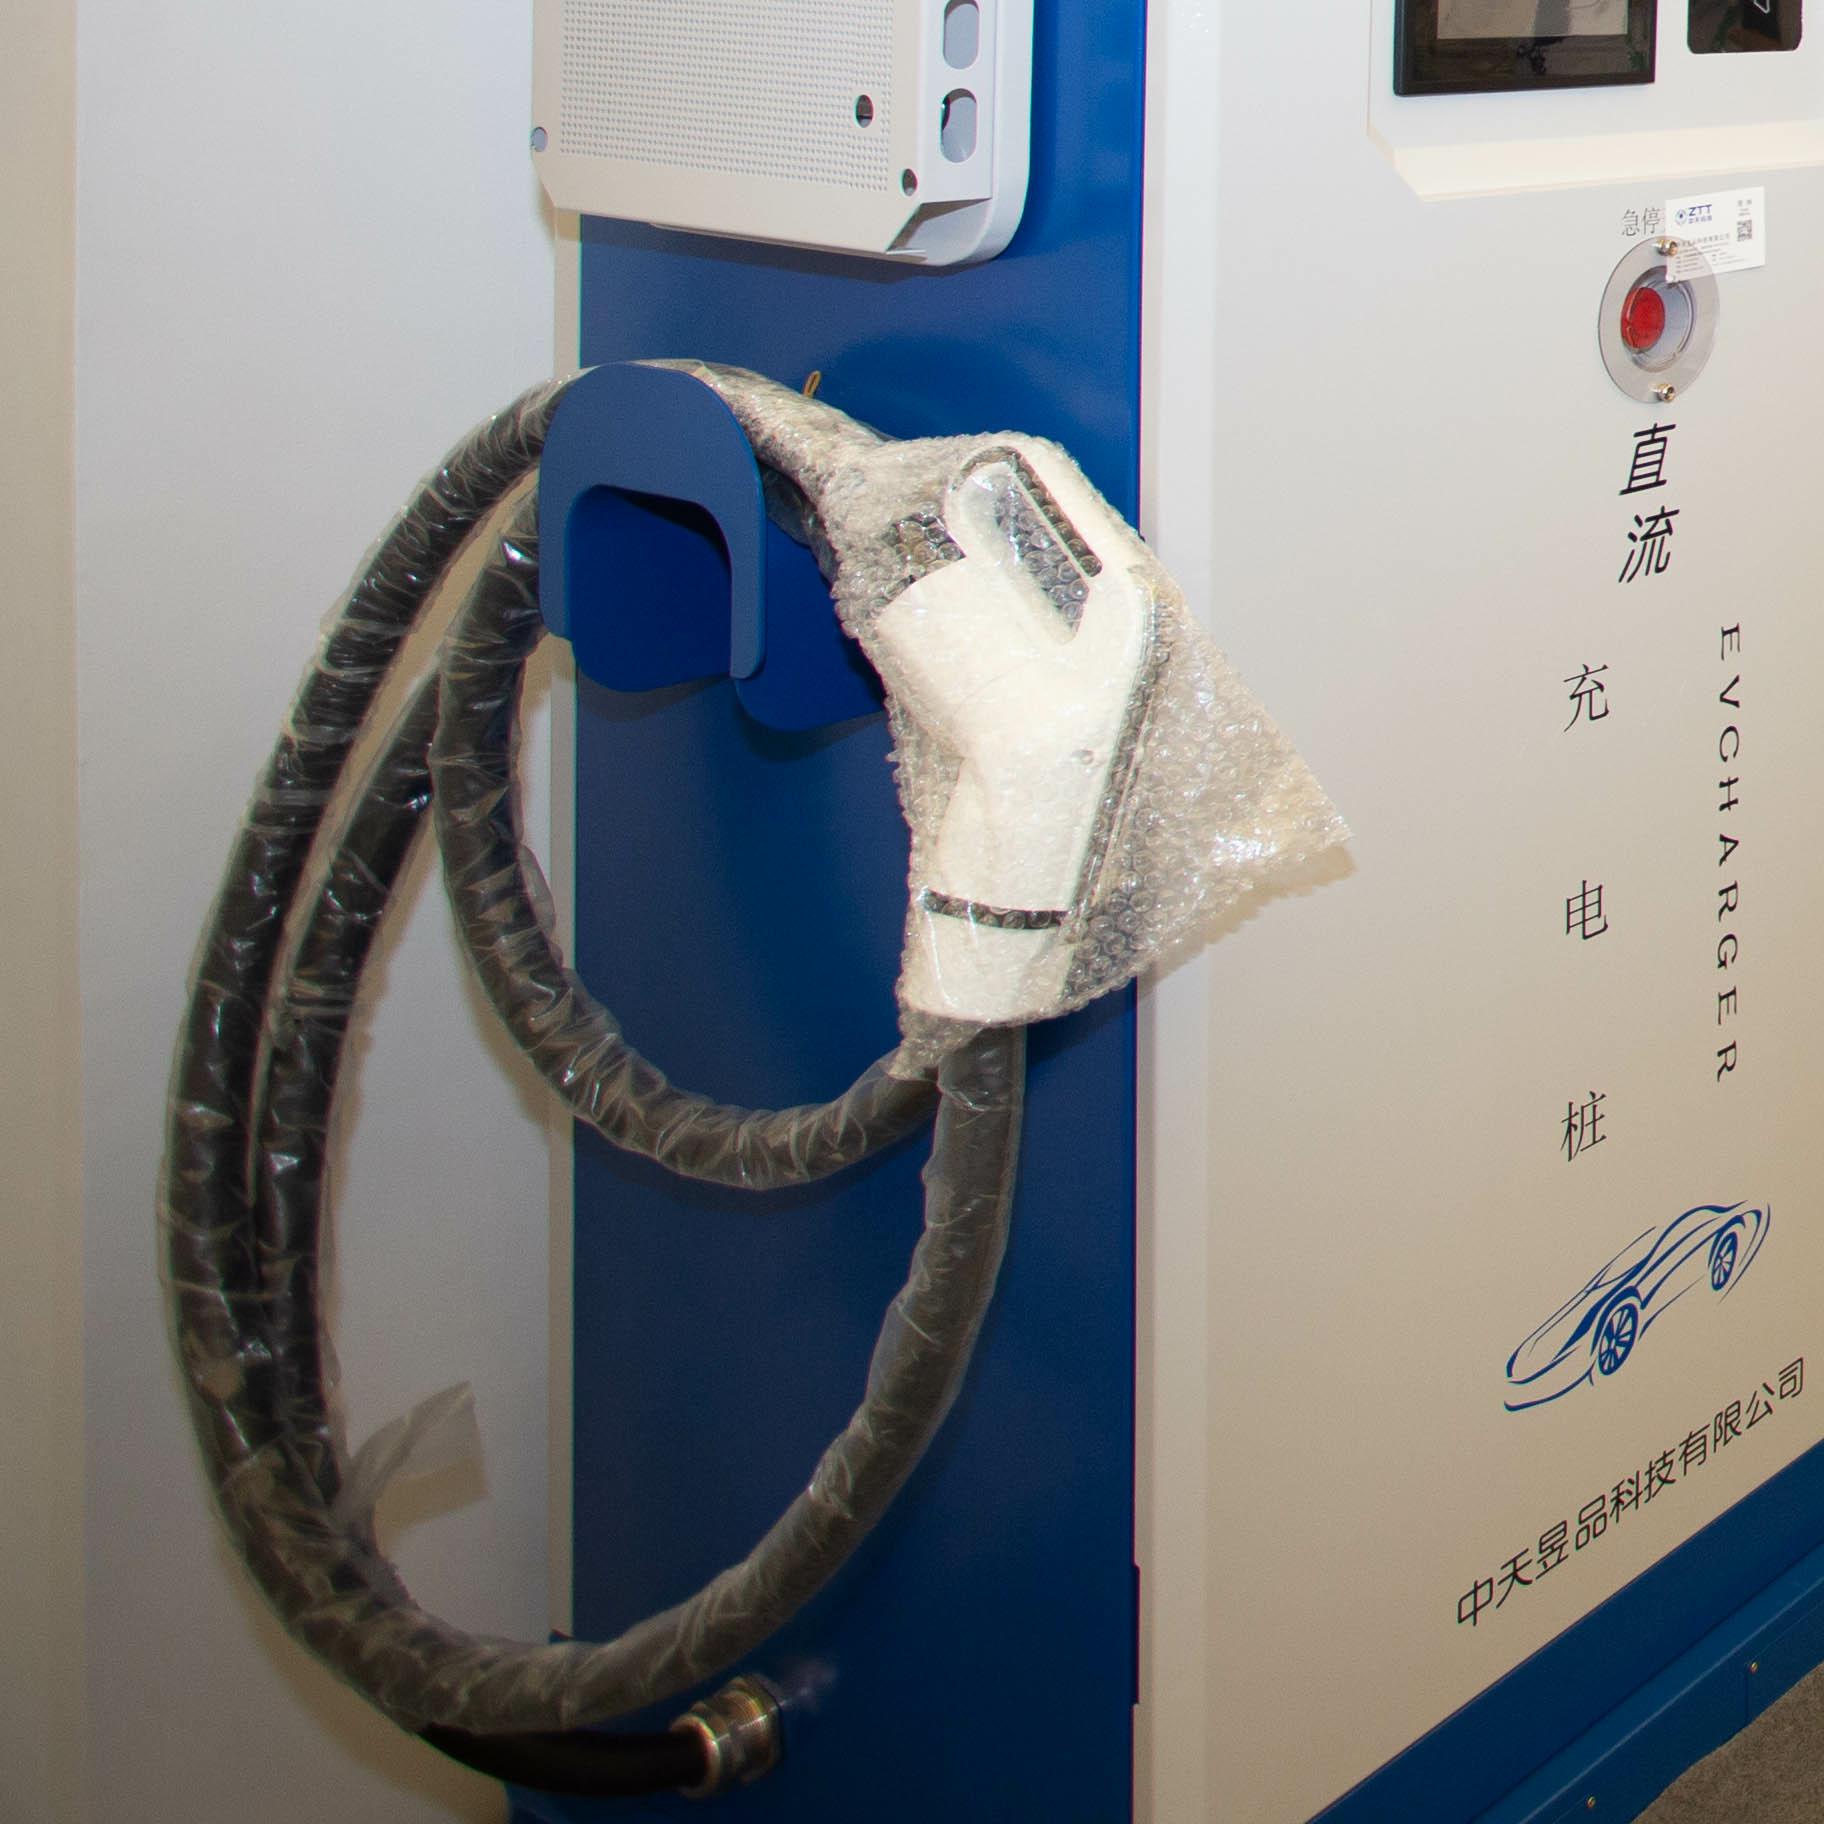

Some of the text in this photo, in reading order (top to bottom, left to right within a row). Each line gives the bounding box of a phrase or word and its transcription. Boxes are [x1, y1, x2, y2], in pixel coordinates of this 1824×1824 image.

[1618, 422, 1680, 584] 直流
[1456, 1356, 1804, 1627] 中天昱品科技有限公司
